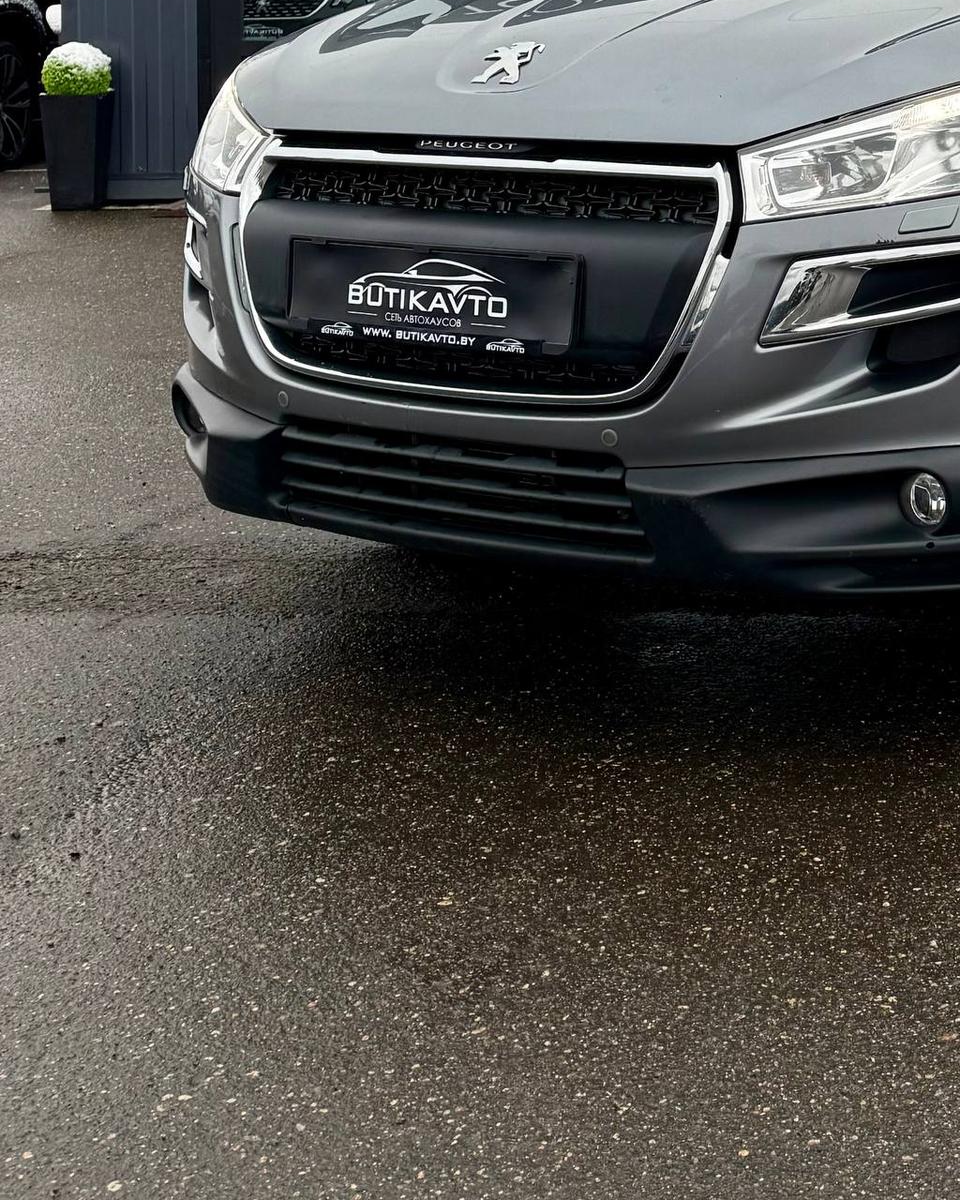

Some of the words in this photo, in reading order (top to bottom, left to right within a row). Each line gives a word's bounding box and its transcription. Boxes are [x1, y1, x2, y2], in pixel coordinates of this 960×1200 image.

[420, 140, 518, 150] PEUGEOT
[348, 284, 508, 318] BUTIKAVTO
[384, 311, 402, 323] СЕТЬ
[403, 314, 462, 329] АВТОХАУСОВ
[362, 326, 392, 339] WWW.
[395, 330, 476, 347] BUTIKAVTO.BY
